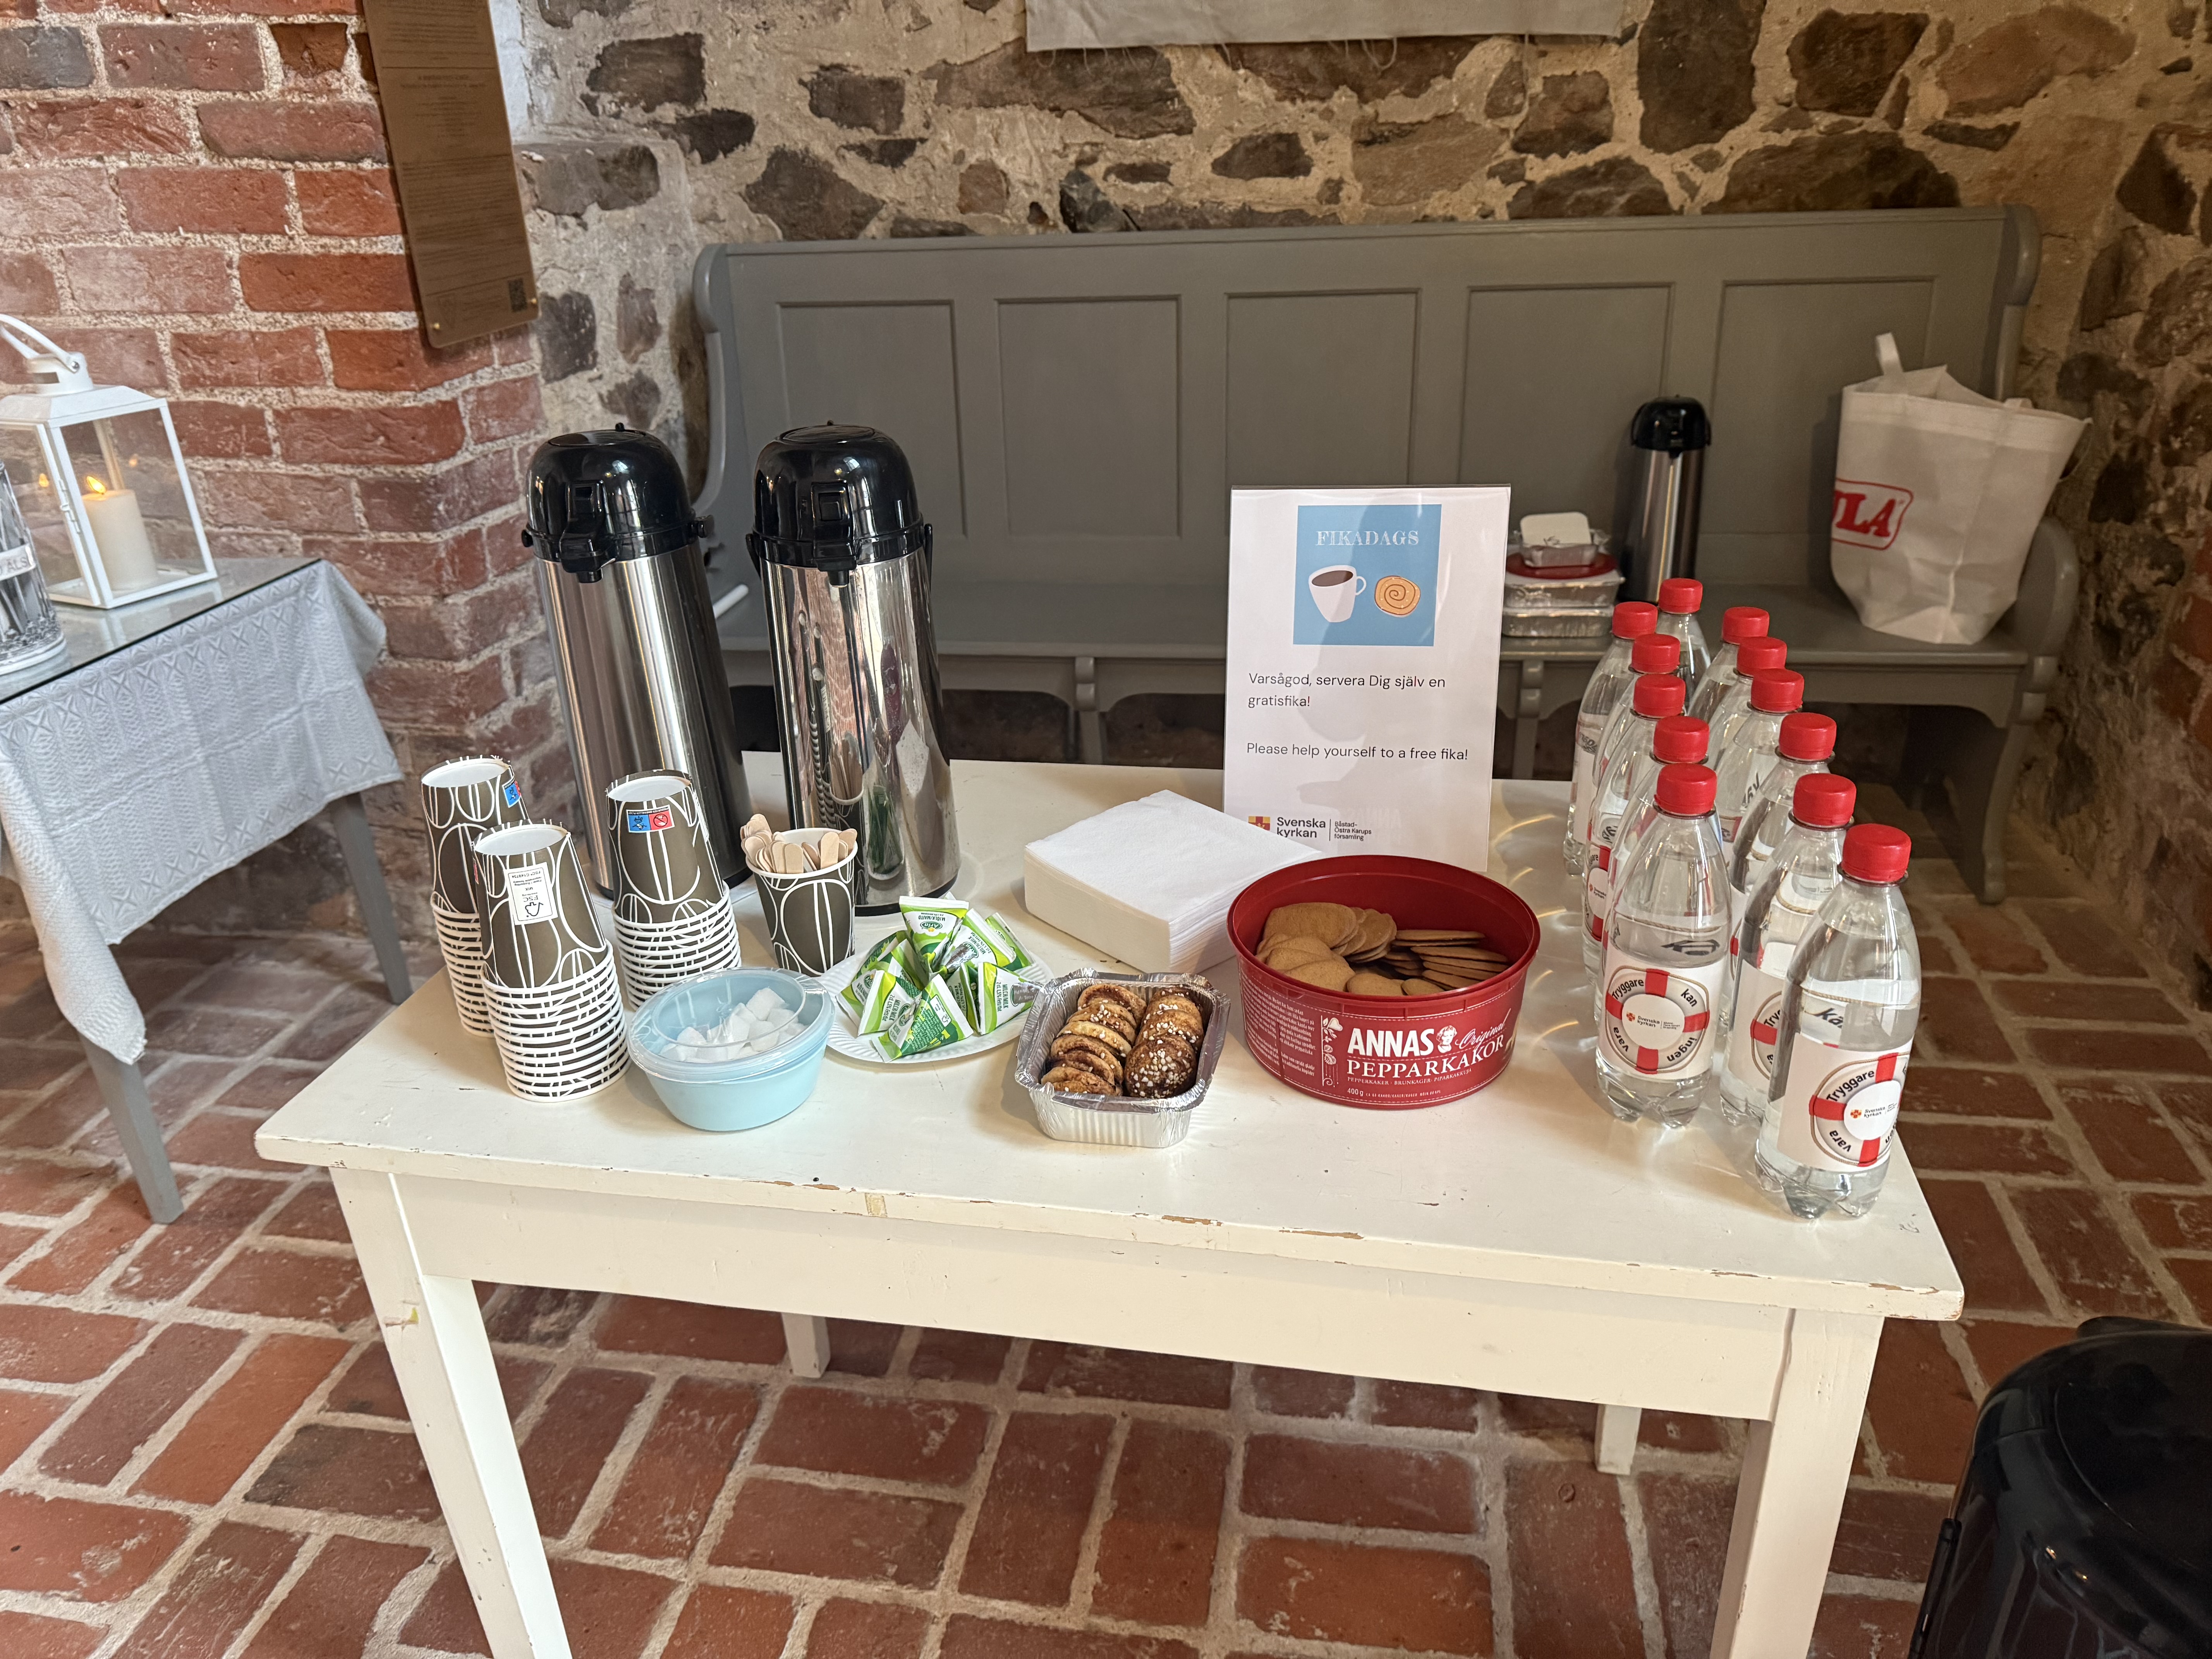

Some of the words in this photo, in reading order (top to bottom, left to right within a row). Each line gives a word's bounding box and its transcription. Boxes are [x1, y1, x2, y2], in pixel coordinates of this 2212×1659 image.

[1315, 531, 1419, 546] FIKADAGS
[1249, 673, 1312, 687] Varsågod,
[1316, 676, 1365, 686] servera
[1369, 675, 1391, 689] Dig
[1395, 676, 1424, 690] själv
[1429, 678, 1446, 688] en
[1248, 696, 1310, 708] gratisfika!
[1247, 743, 1288, 755] Please
[1292, 744, 1319, 758] help
[1324, 746, 1376, 758] yourself
[1381, 748, 1394, 758] to
[1398, 750, 1406, 759] a
[1410, 747, 1436, 759] free
[1441, 749, 1468, 760] fika!
[1277, 817, 1326, 828] Svenska
[1277, 827, 1317, 838] kyrkan
[968, 936, 986, 954] MILCH/MILK
[1611, 979, 1645, 1000] Tryggare
[1680, 988, 1698, 1007] kan
[889, 999, 901, 1021] MILCH/MILK
[1637, 1019, 1656, 1027] kyrkan
[1638, 1015, 1660, 1024] Svenska
[1347, 1027, 1434, 1057] ANNAS
[1455, 1008, 1511, 1051] Original
[1613, 1027, 1629, 1052] vara
[1346, 1034, 1504, 1078] PEPPARKAKOR
[1666, 1037, 1698, 1062] ingen
[1347, 1077, 1389, 1085] PEPPERKAKER
[1826, 1070, 1875, 1103] Tryggare
[1829, 1130, 1852, 1152] vara
